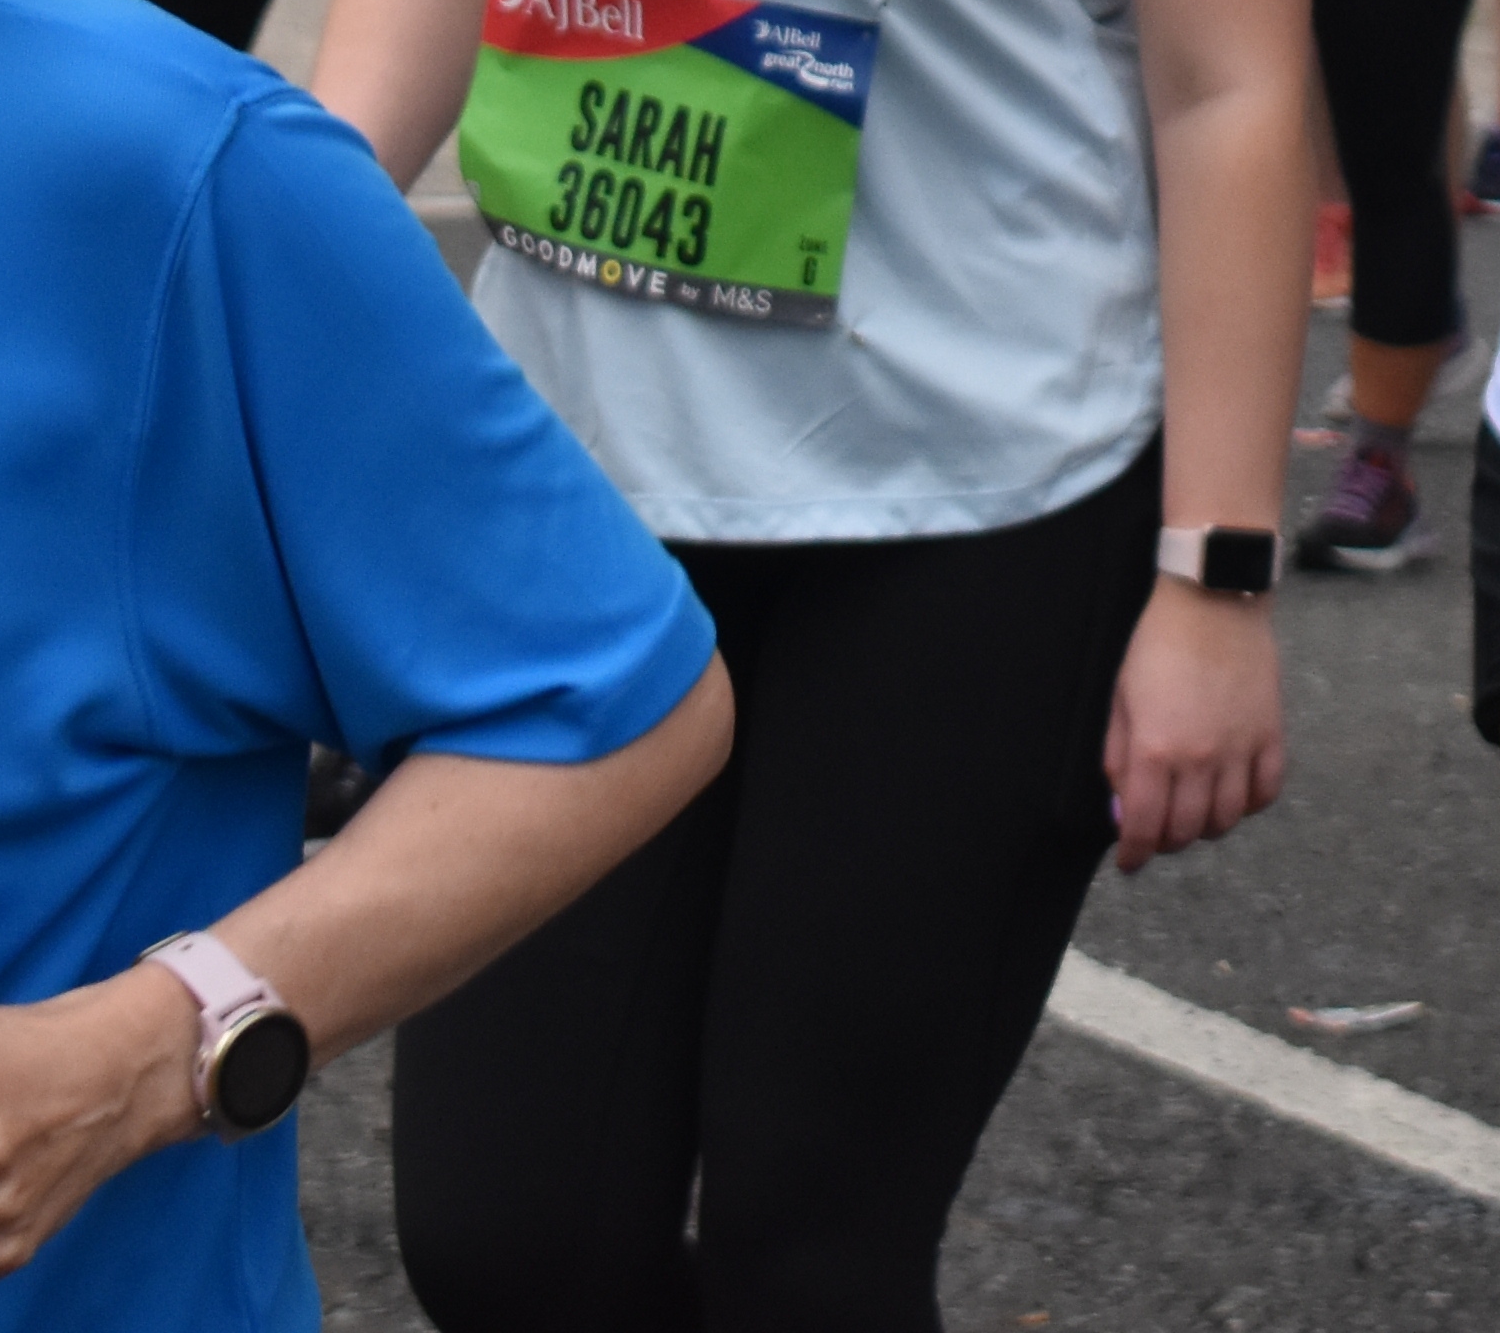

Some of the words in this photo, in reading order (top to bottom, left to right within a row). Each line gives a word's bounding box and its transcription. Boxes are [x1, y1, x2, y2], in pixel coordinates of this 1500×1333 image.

[570, 80, 728, 187] SARAH
[548, 159, 714, 267] 36043
[502, 225, 668, 295] GOODMOVE
[712, 283, 773, 313] M&S
